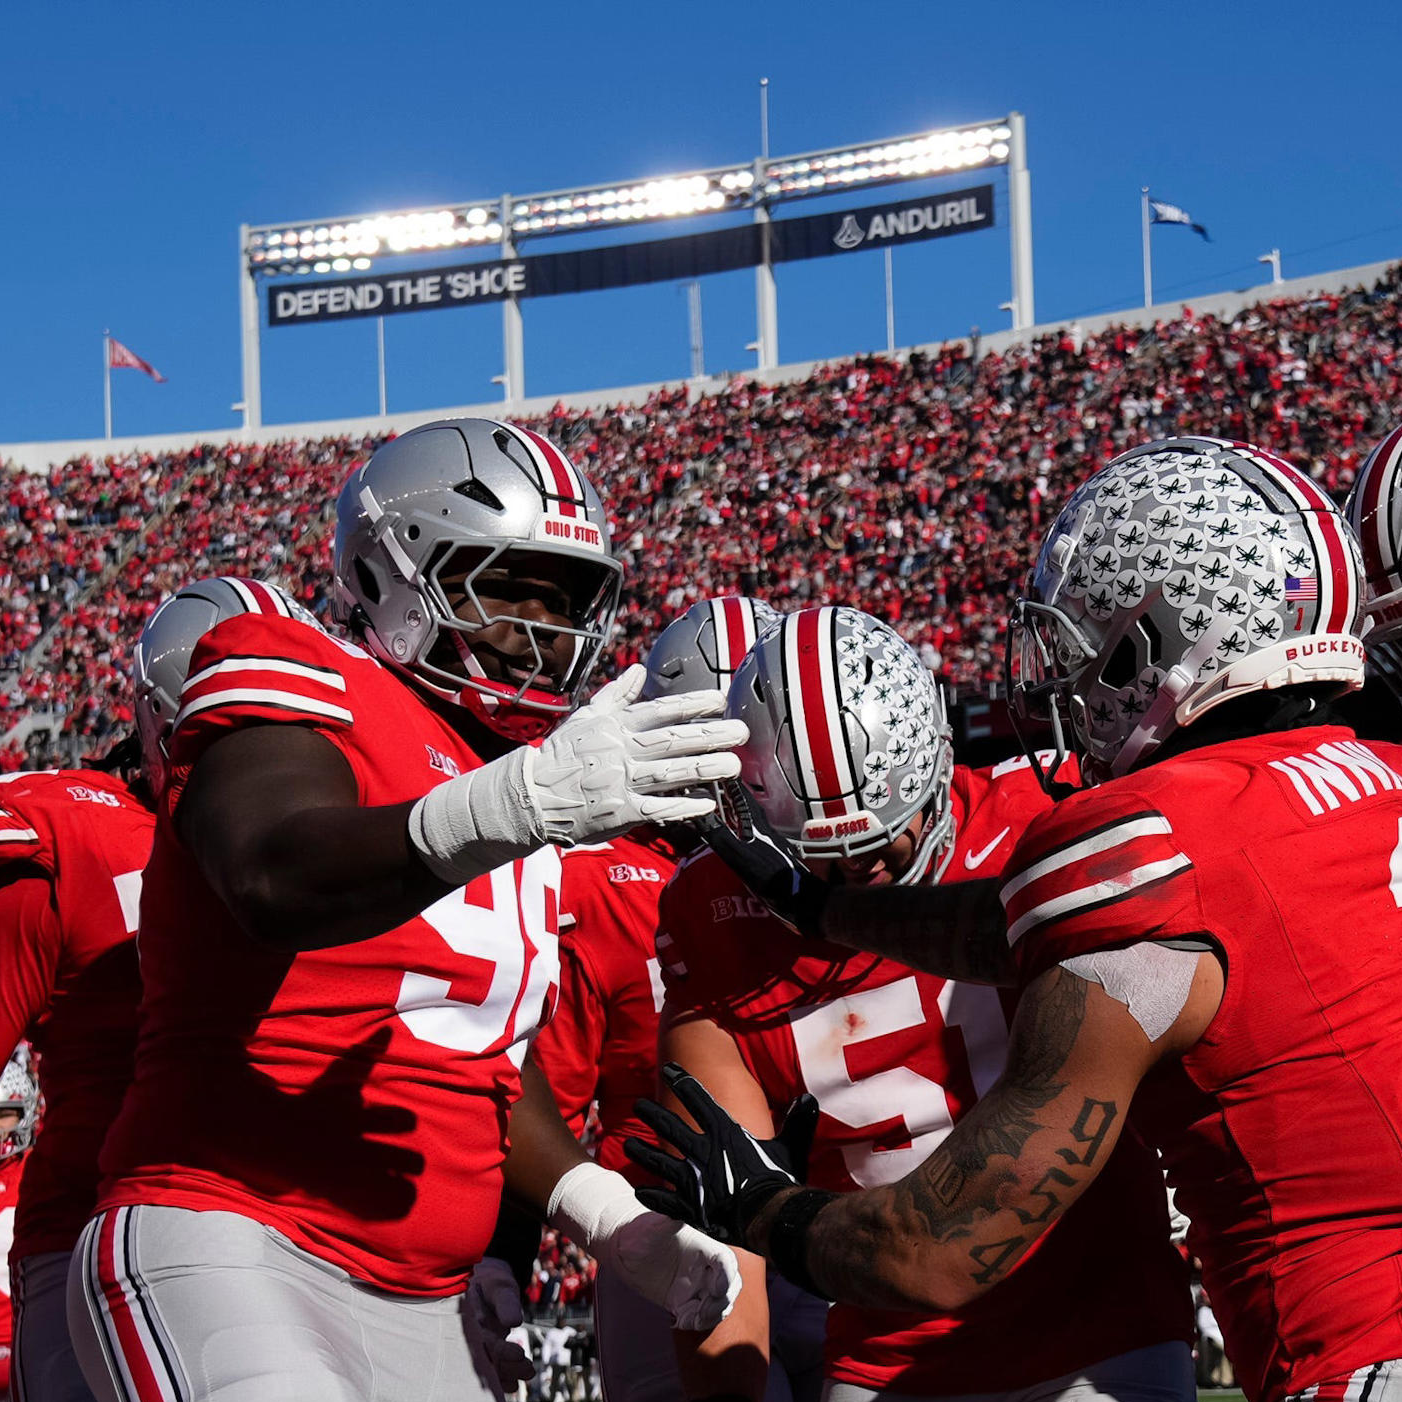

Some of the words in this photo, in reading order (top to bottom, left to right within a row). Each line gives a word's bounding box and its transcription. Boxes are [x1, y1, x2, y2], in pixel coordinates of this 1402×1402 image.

[866, 197, 986, 241] ANDURIL
[276, 283, 384, 318] DEFEND
[386, 276, 442, 307] THE
[574, 525, 599, 546] STATE
